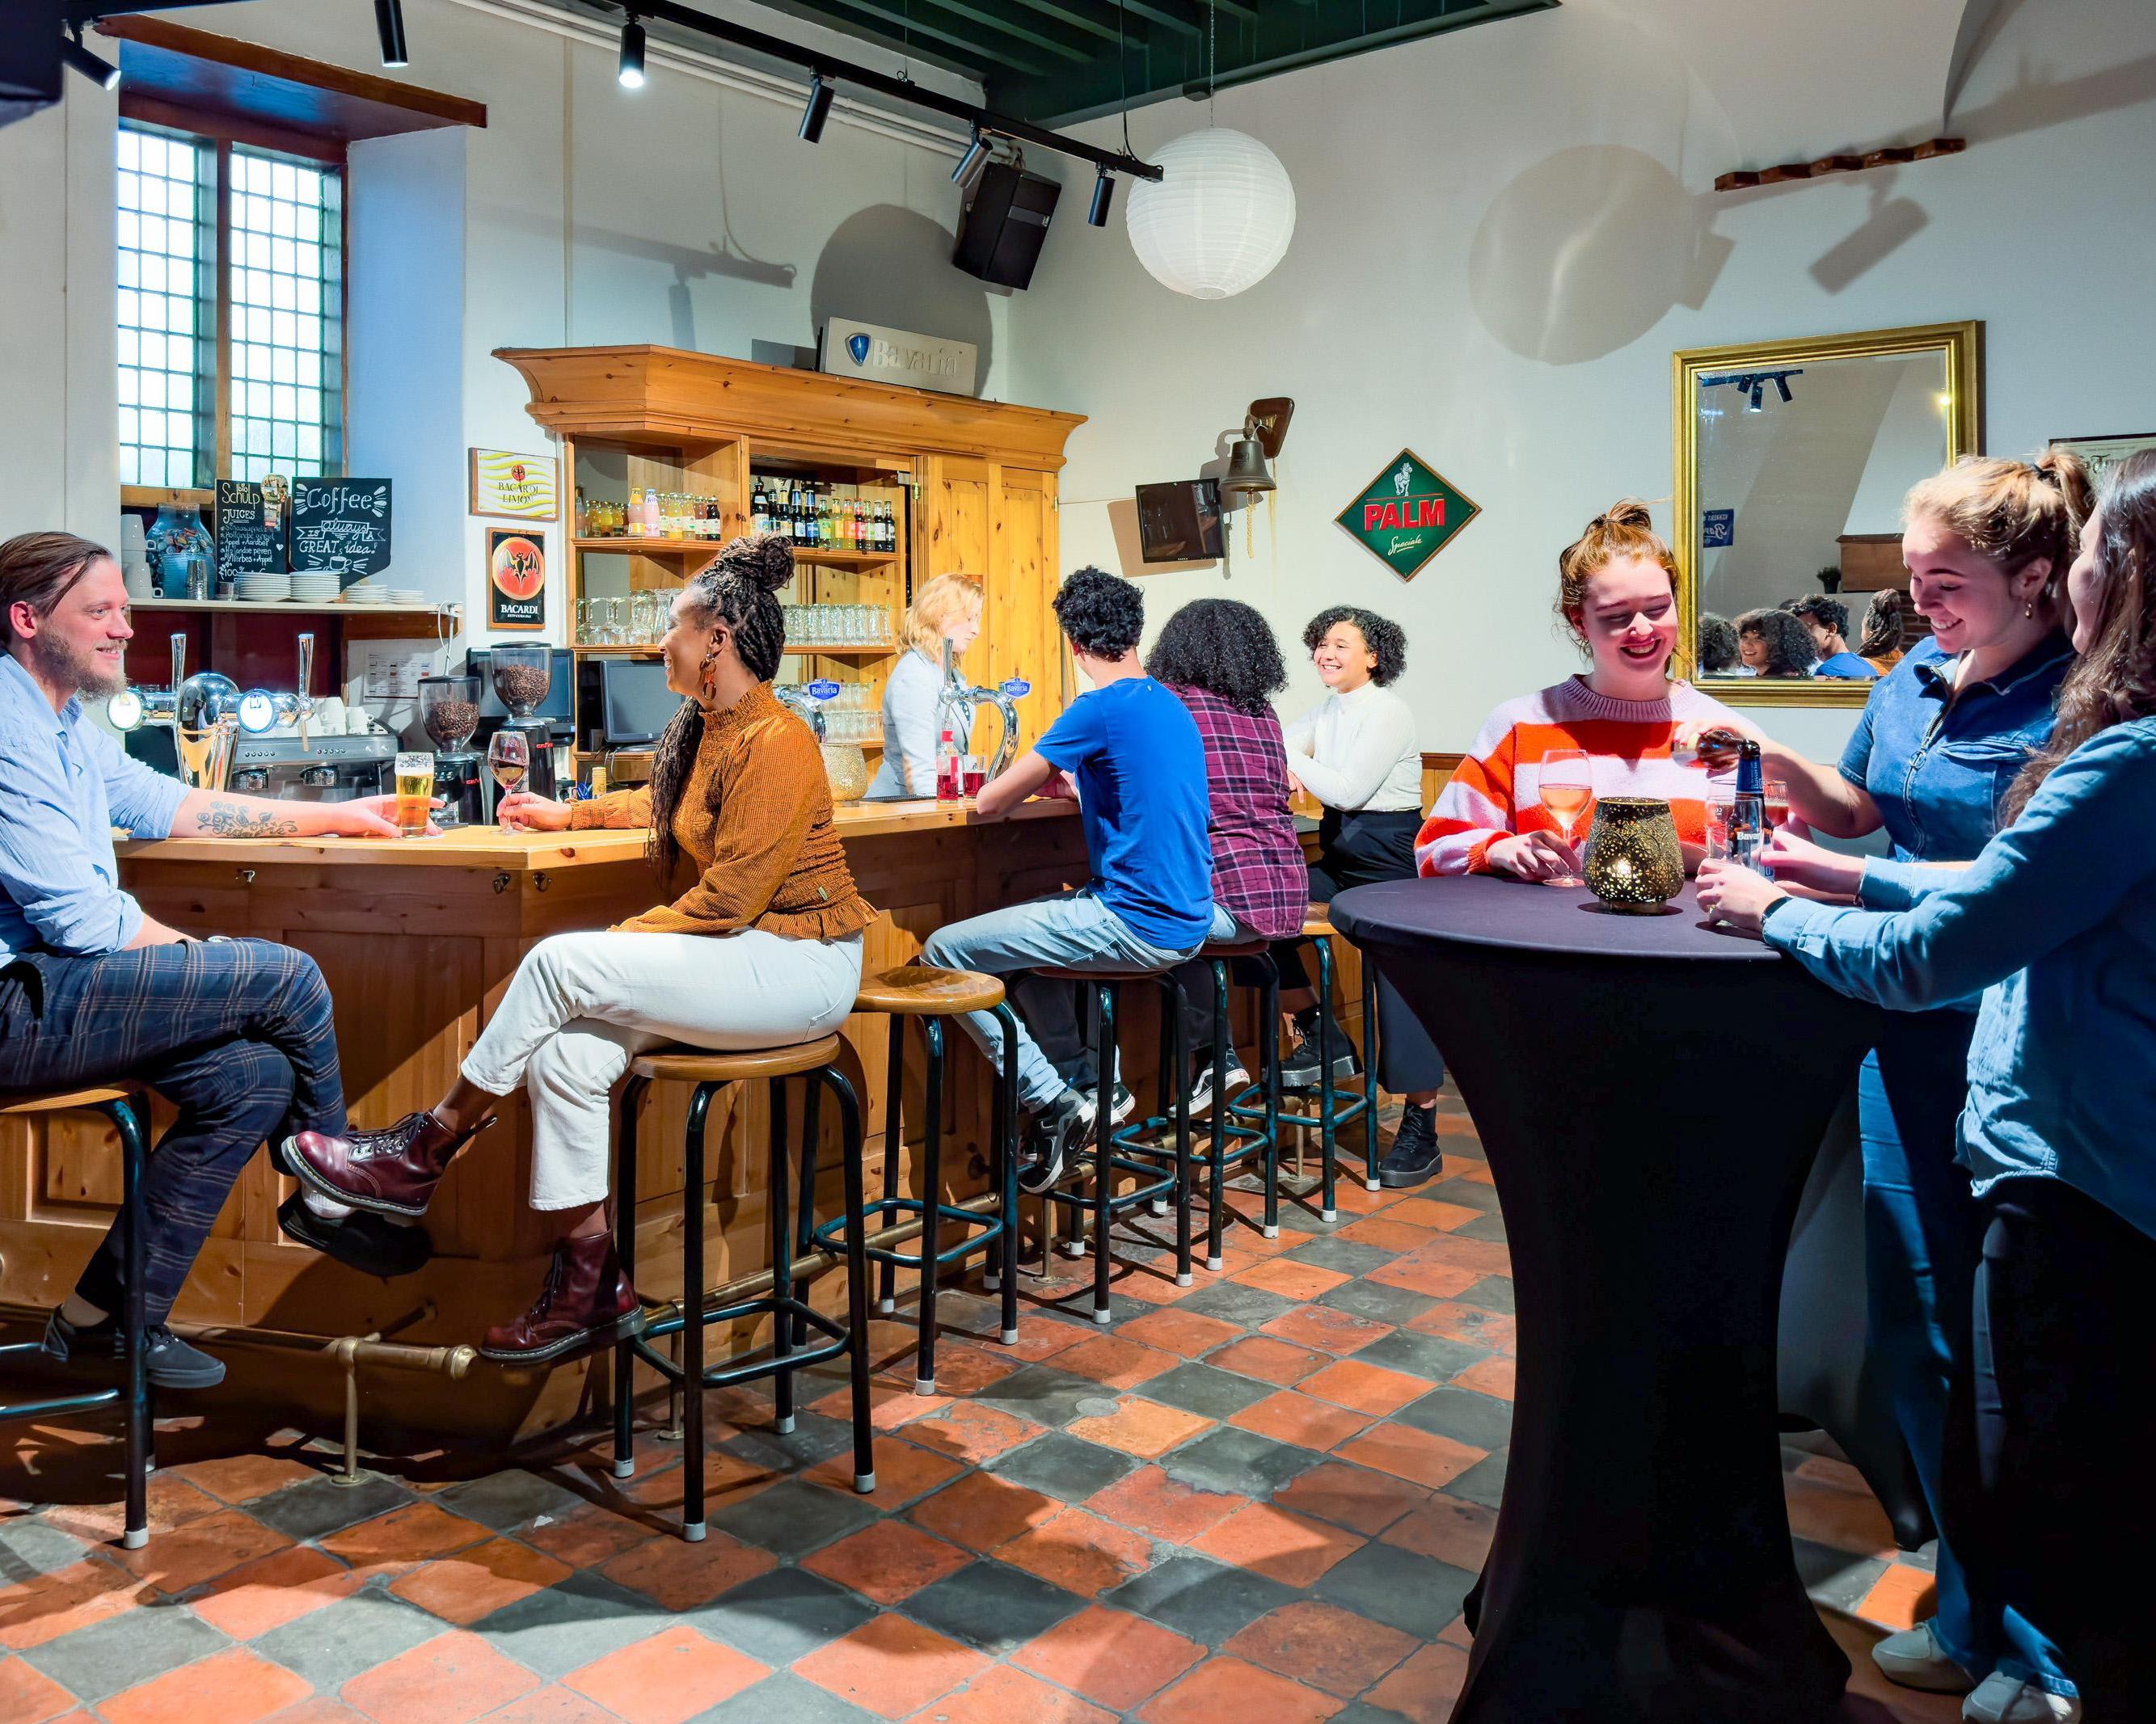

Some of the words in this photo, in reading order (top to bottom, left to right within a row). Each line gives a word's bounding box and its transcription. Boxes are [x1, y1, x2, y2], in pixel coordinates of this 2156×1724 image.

[872, 339, 957, 377] Bavaria
[238, 483, 248, 492] bio
[498, 482, 539, 495] BACARDI
[307, 487, 372, 515] Coffee
[222, 508, 255, 524] JUICES
[1364, 499, 1445, 531] PALM
[323, 518, 366, 540] always
[366, 531, 374, 540] A
[299, 540, 340, 554] GREAT
[344, 541, 378, 554] idea!
[1388, 534, 1423, 555] Speciale
[500, 604, 538, 614] BACARDI
[812, 687, 838, 695] Bavaria
[1006, 685, 1028, 693] Bavaria
